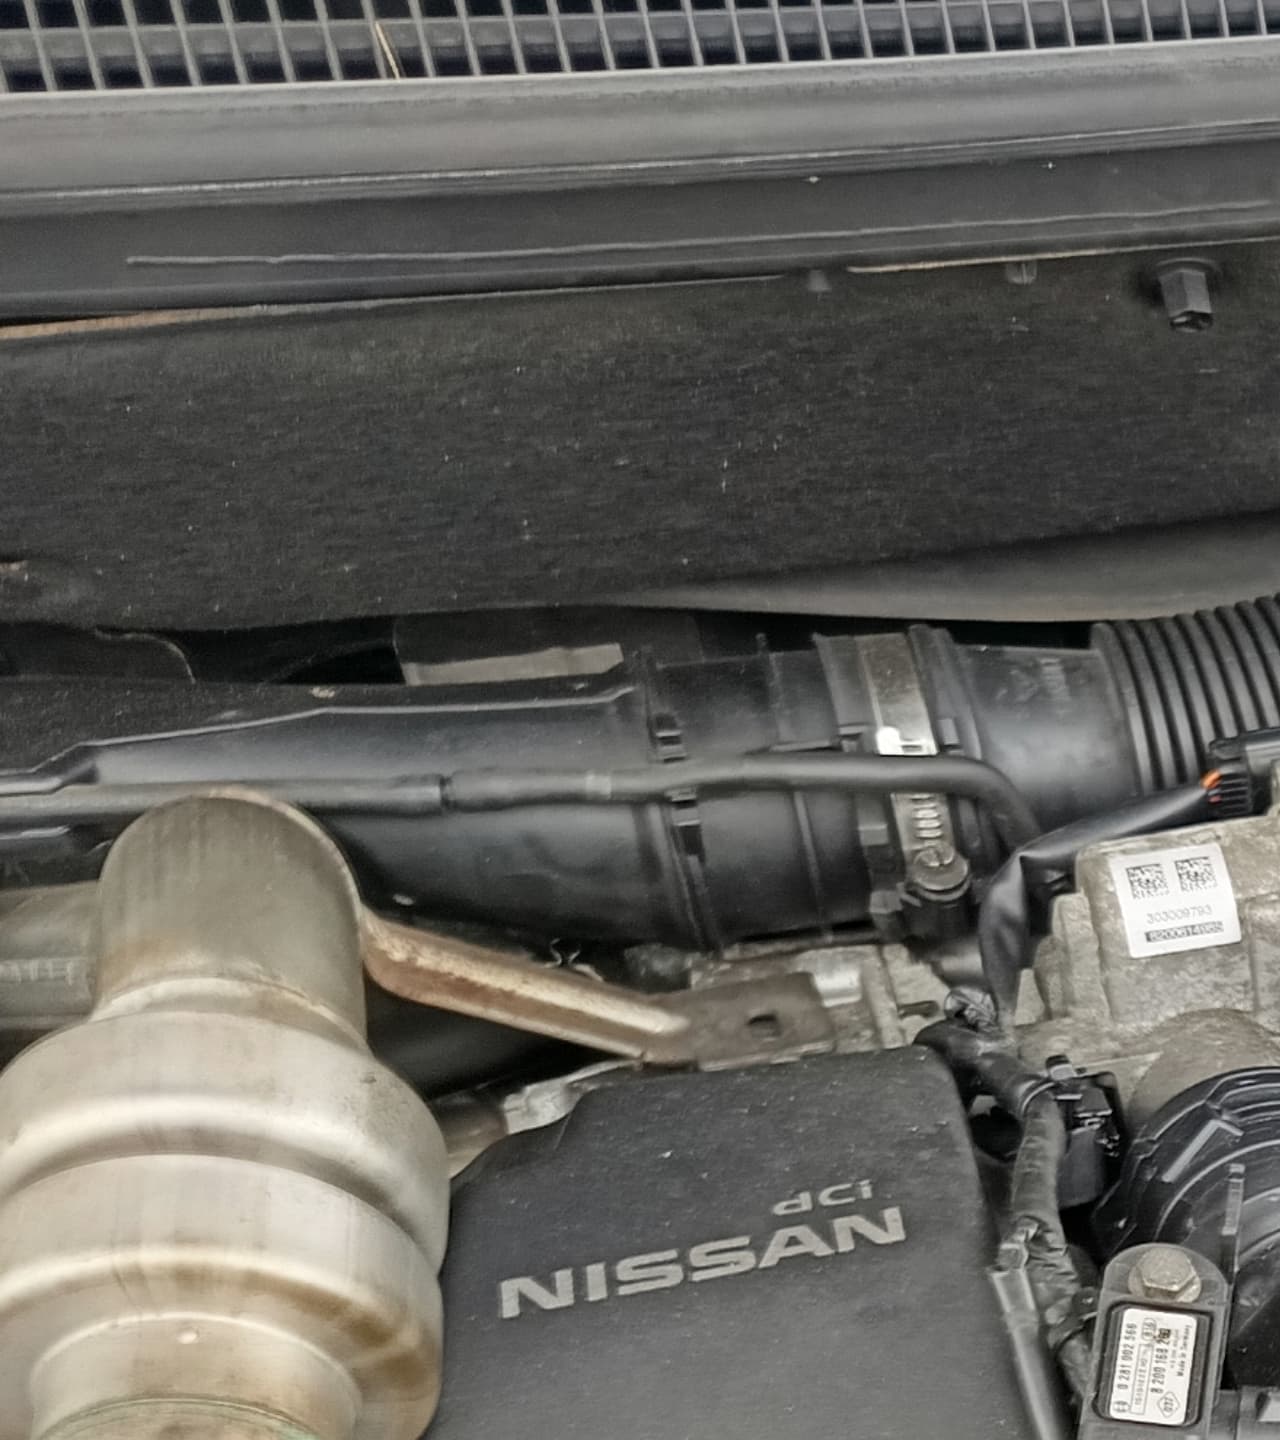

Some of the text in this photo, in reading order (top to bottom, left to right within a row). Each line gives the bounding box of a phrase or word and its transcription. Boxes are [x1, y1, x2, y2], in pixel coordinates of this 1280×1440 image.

[498, 1207, 905, 1319] NISSAN
[1121, 1343, 1134, 1361] 002
[1118, 1364, 1132, 1381] 281
